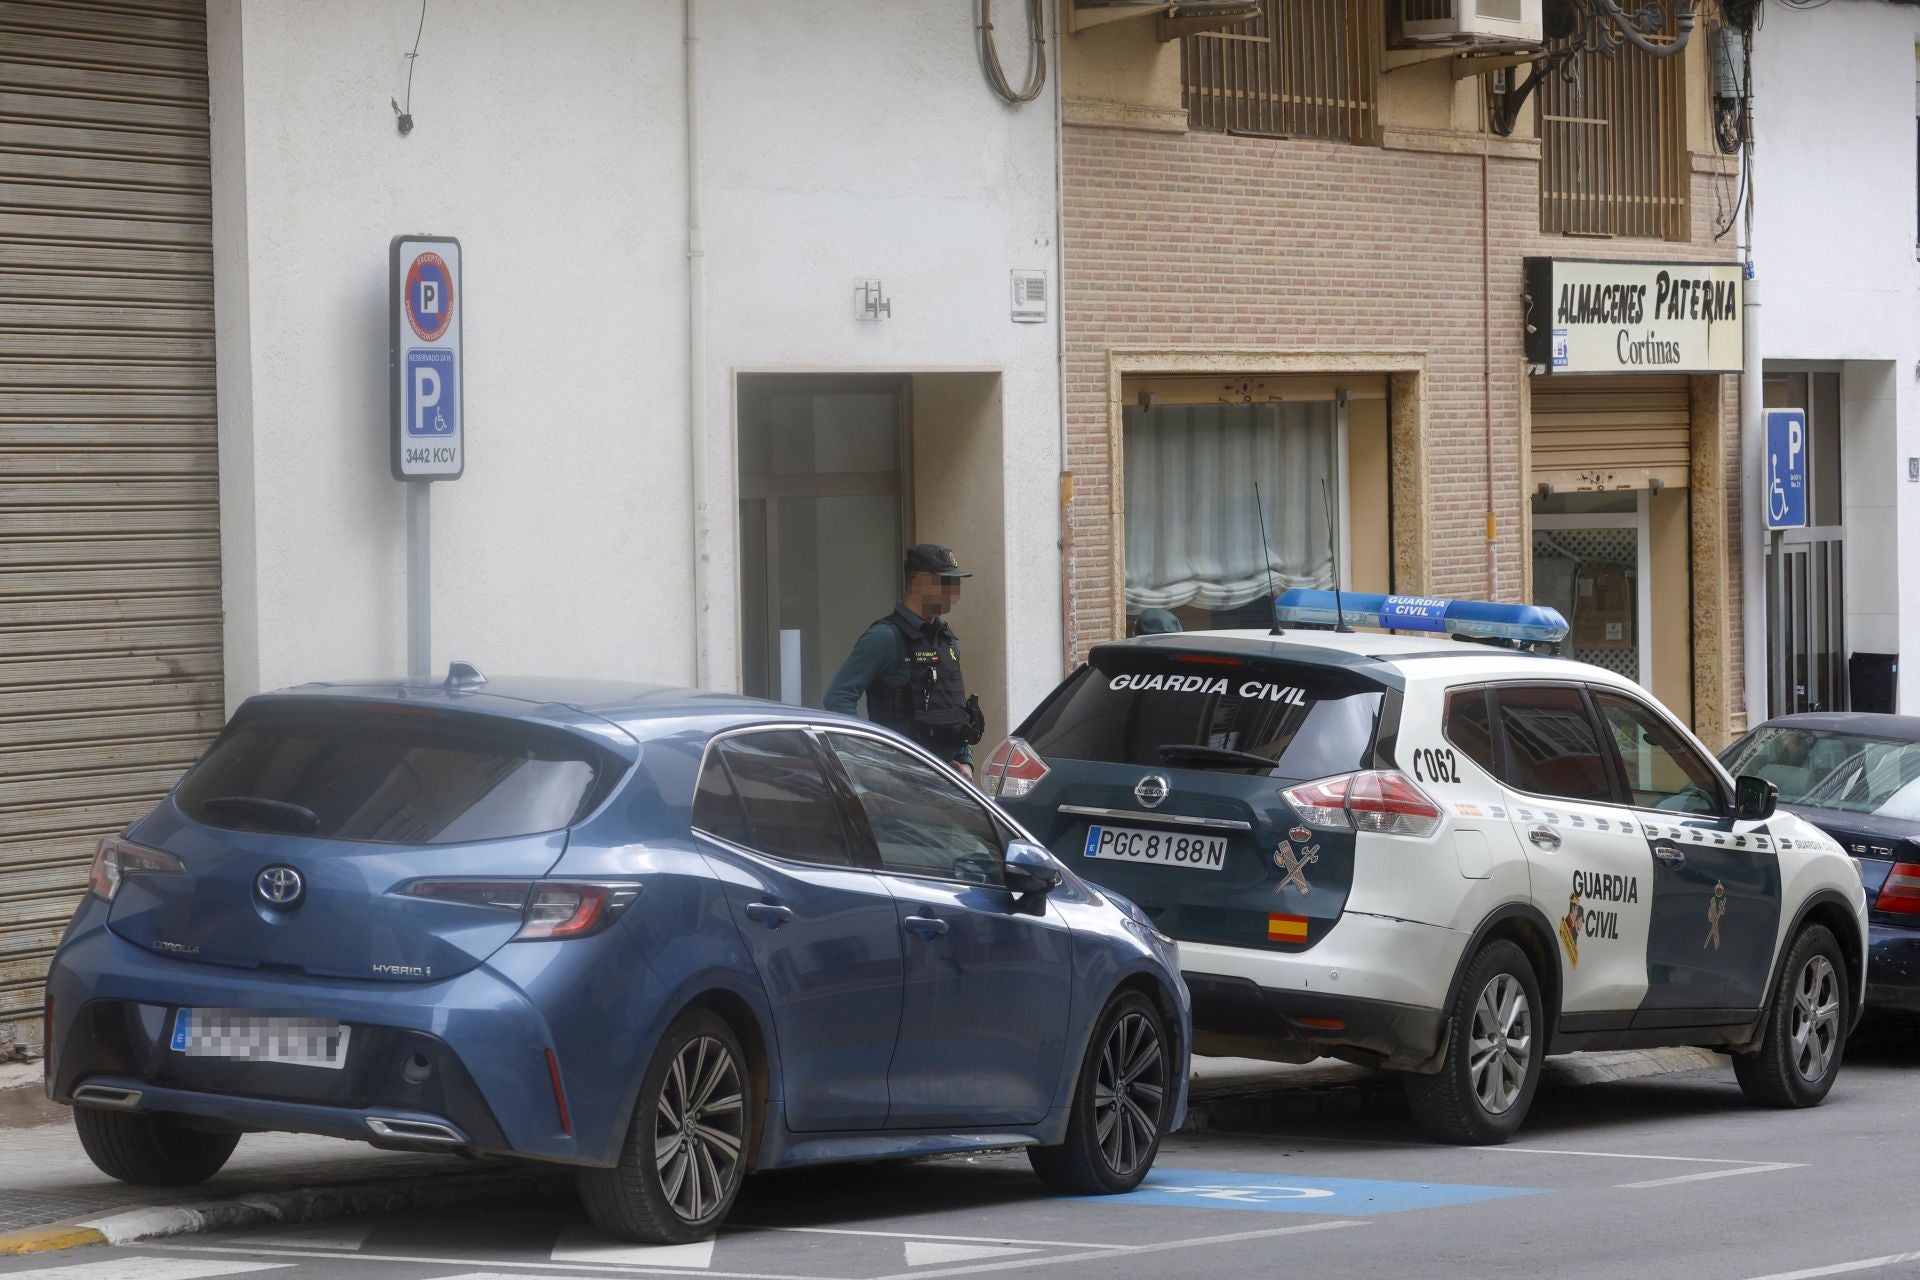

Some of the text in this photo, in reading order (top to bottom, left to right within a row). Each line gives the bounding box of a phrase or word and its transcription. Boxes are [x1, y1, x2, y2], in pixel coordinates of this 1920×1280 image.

[417, 254, 442, 266] EXCEPTO
[424, 285, 435, 310] P
[1558, 270, 1736, 324] ALMACENES PATERNA
[408, 353, 440, 362] RESERVADO
[1616, 329, 1681, 365] Cortinas
[415, 367, 441, 429] P
[406, 447, 456, 463] 3442 KCV
[1788, 420, 1802, 470] P
[1388, 596, 1445, 608] GUARDIA
[1395, 605, 1429, 616] CIVIL
[1109, 674, 1306, 706] GUARDIA CIVIL
[1870, 845, 1893, 856] TDI
[1573, 869, 1638, 904] GUARDIA
[1585, 909, 1619, 940] CIVIL
[373, 964, 422, 976] HYBRID
